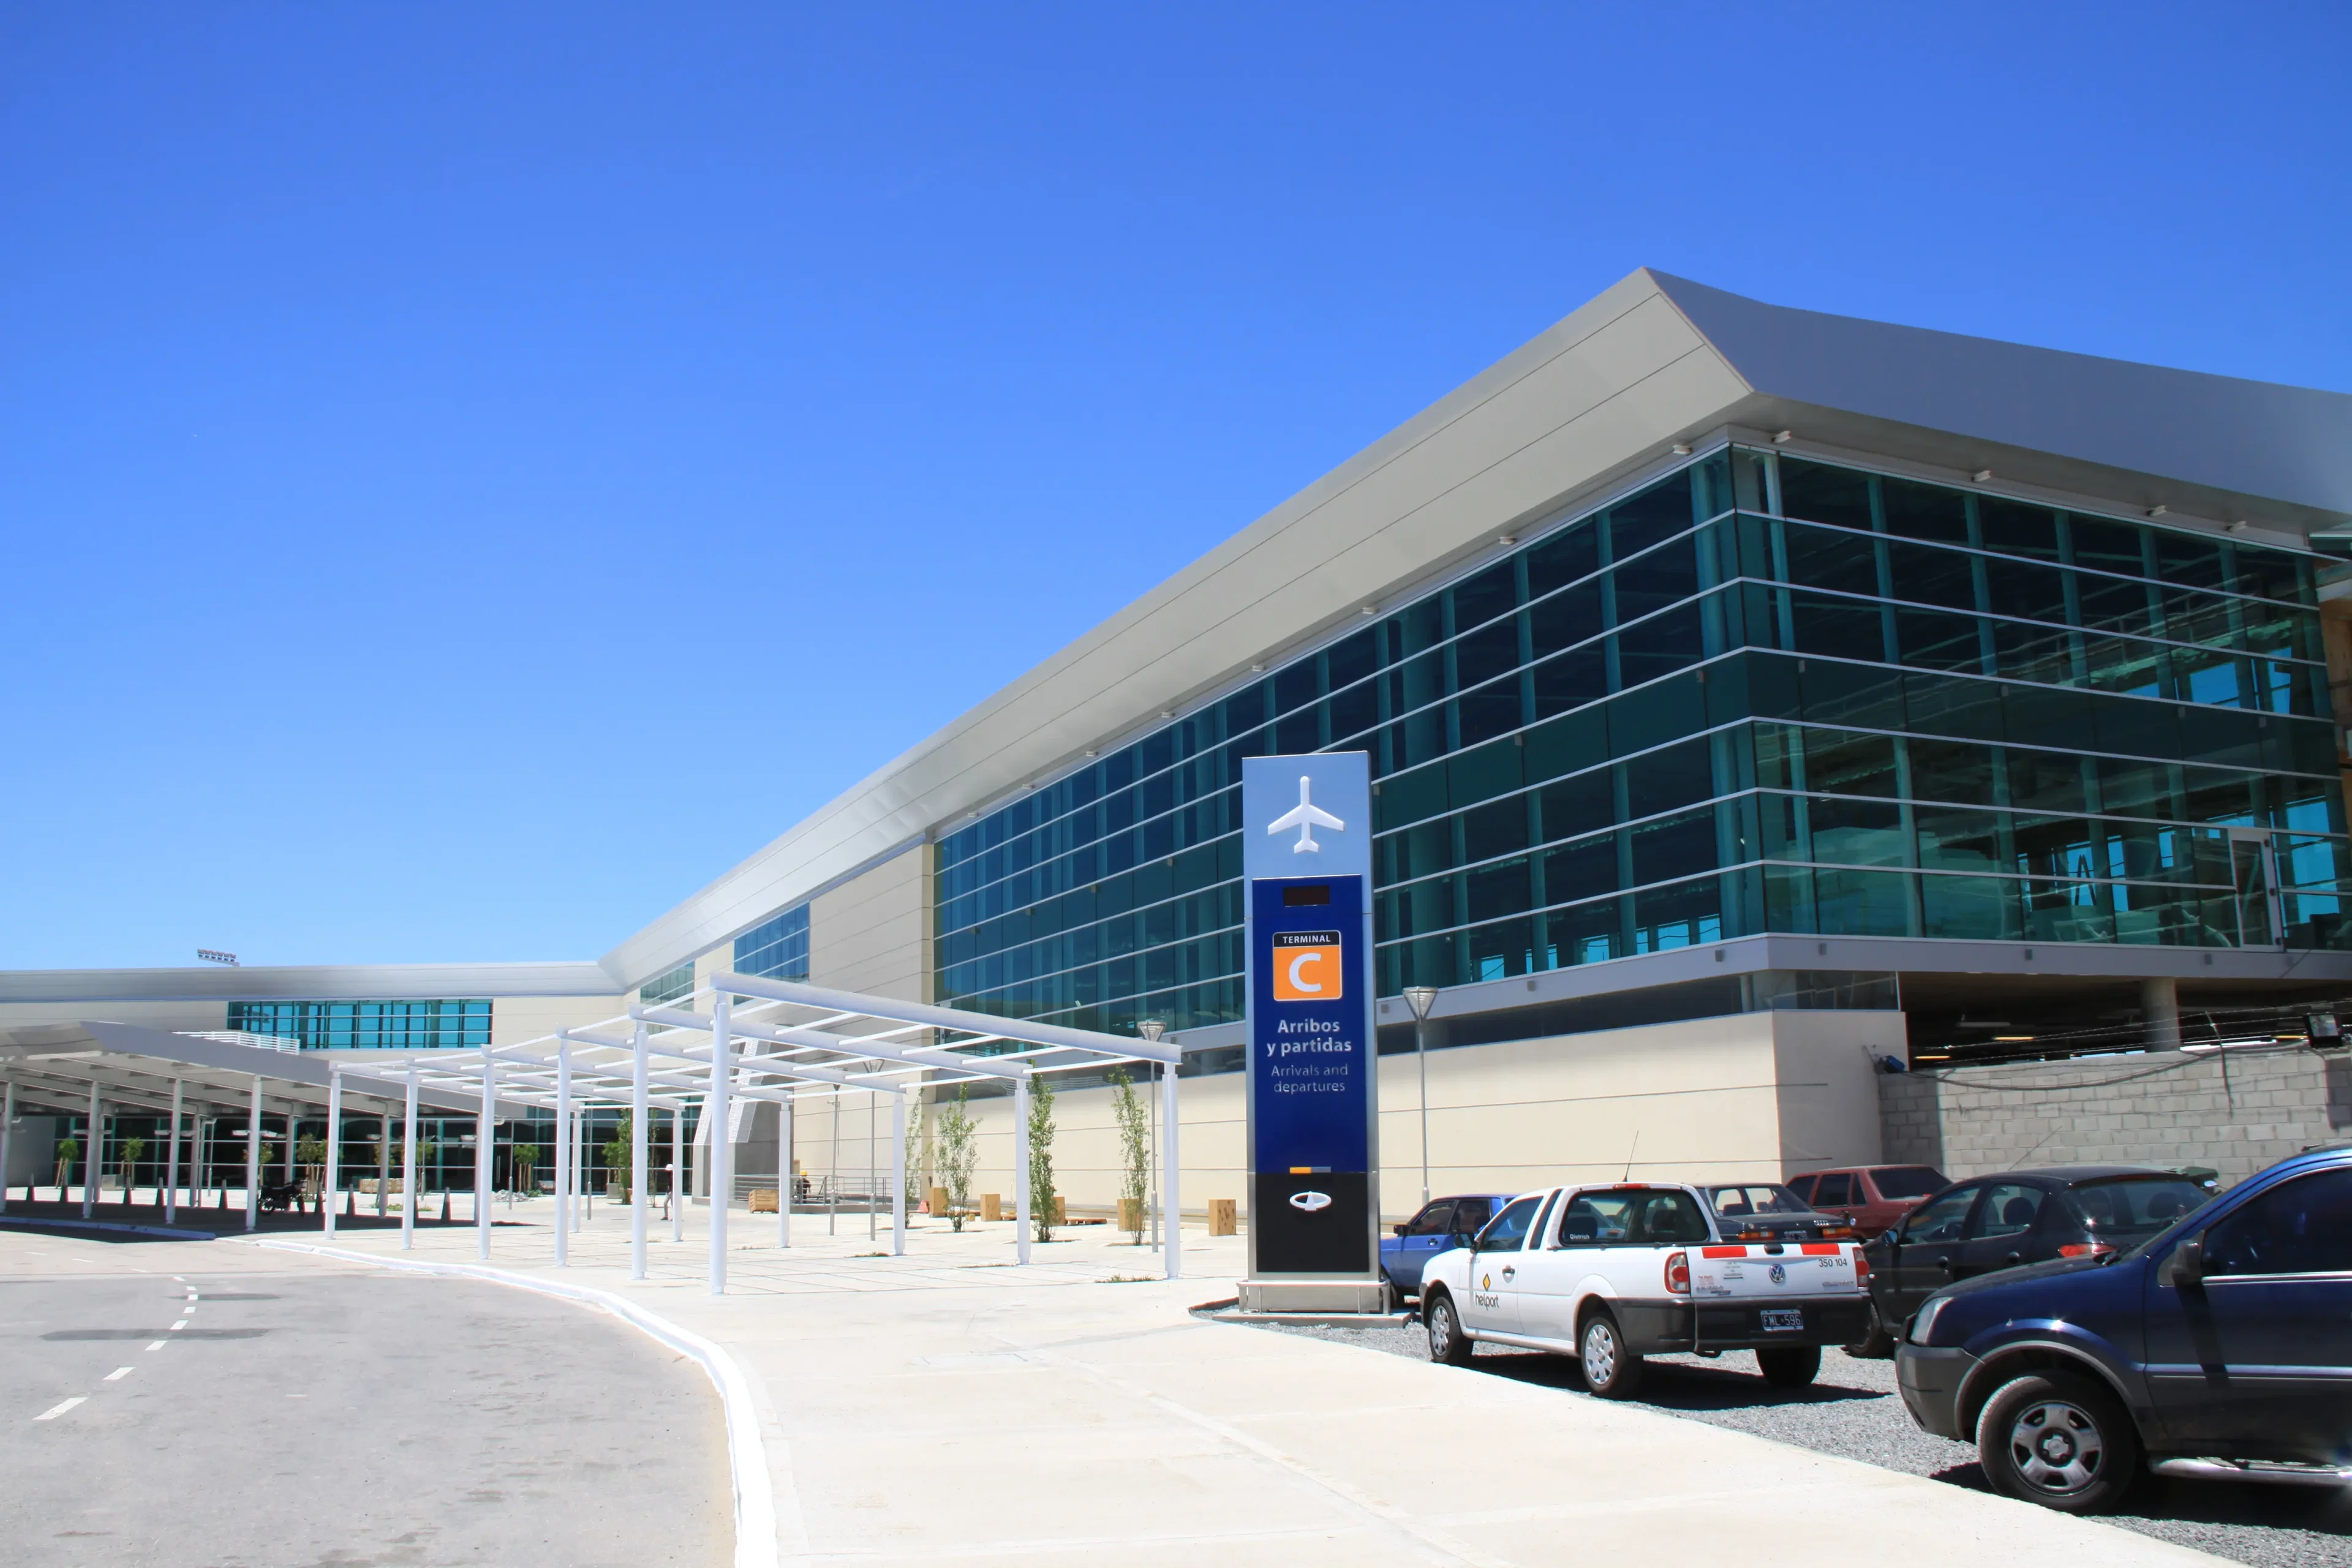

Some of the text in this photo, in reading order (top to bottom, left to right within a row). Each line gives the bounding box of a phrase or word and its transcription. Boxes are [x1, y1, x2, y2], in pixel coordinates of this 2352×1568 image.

[1283, 935, 1331, 944] TERMINAL
[1289, 952, 1322, 992] C
[1278, 1018, 1340, 1033] Arribos
[1267, 1038, 1352, 1057] y partidas
[1272, 1064, 1348, 1077] Arrivals and
[1274, 1080, 1345, 1095] departures
[1819, 1258, 1847, 1267] 350 104
[1475, 1292, 1499, 1311] helport
